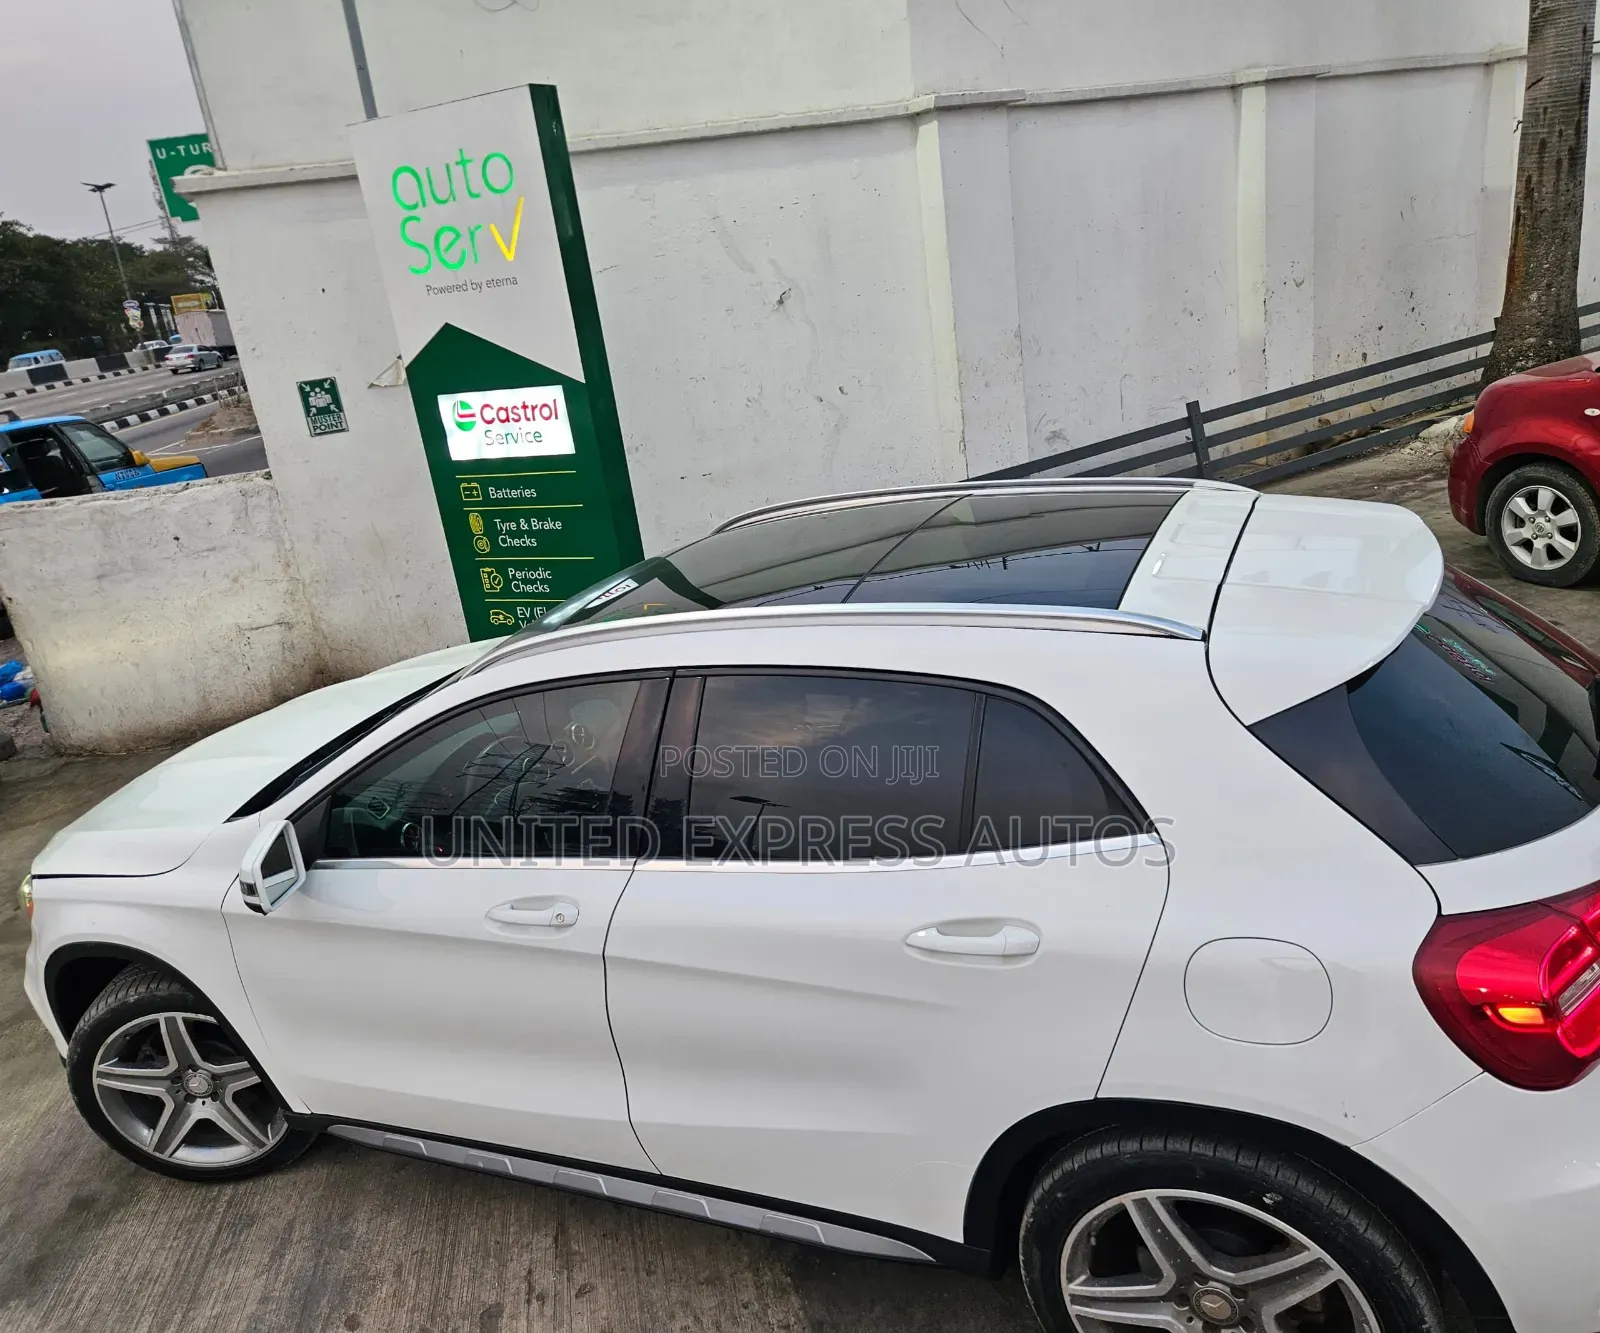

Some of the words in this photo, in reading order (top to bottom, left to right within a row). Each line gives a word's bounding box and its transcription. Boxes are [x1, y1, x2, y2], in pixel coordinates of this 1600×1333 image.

[391, 148, 514, 211] auto
[425, 279, 468, 296] Powered
[469, 278, 483, 293] by
[485, 276, 518, 289] eterna
[480, 398, 558, 425] Castrol
[310, 413, 342, 426] MUSTER
[312, 421, 344, 433] POINT
[484, 427, 543, 446] Service
[488, 486, 537, 499] Batteries
[493, 519, 517, 534] Tyre
[519, 518, 529, 530] &
[530, 517, 563, 530] Brake
[498, 534, 537, 547] Checks
[508, 567, 552, 579] Periodic
[511, 581, 550, 593] Checks
[516, 606, 531, 618] EV
